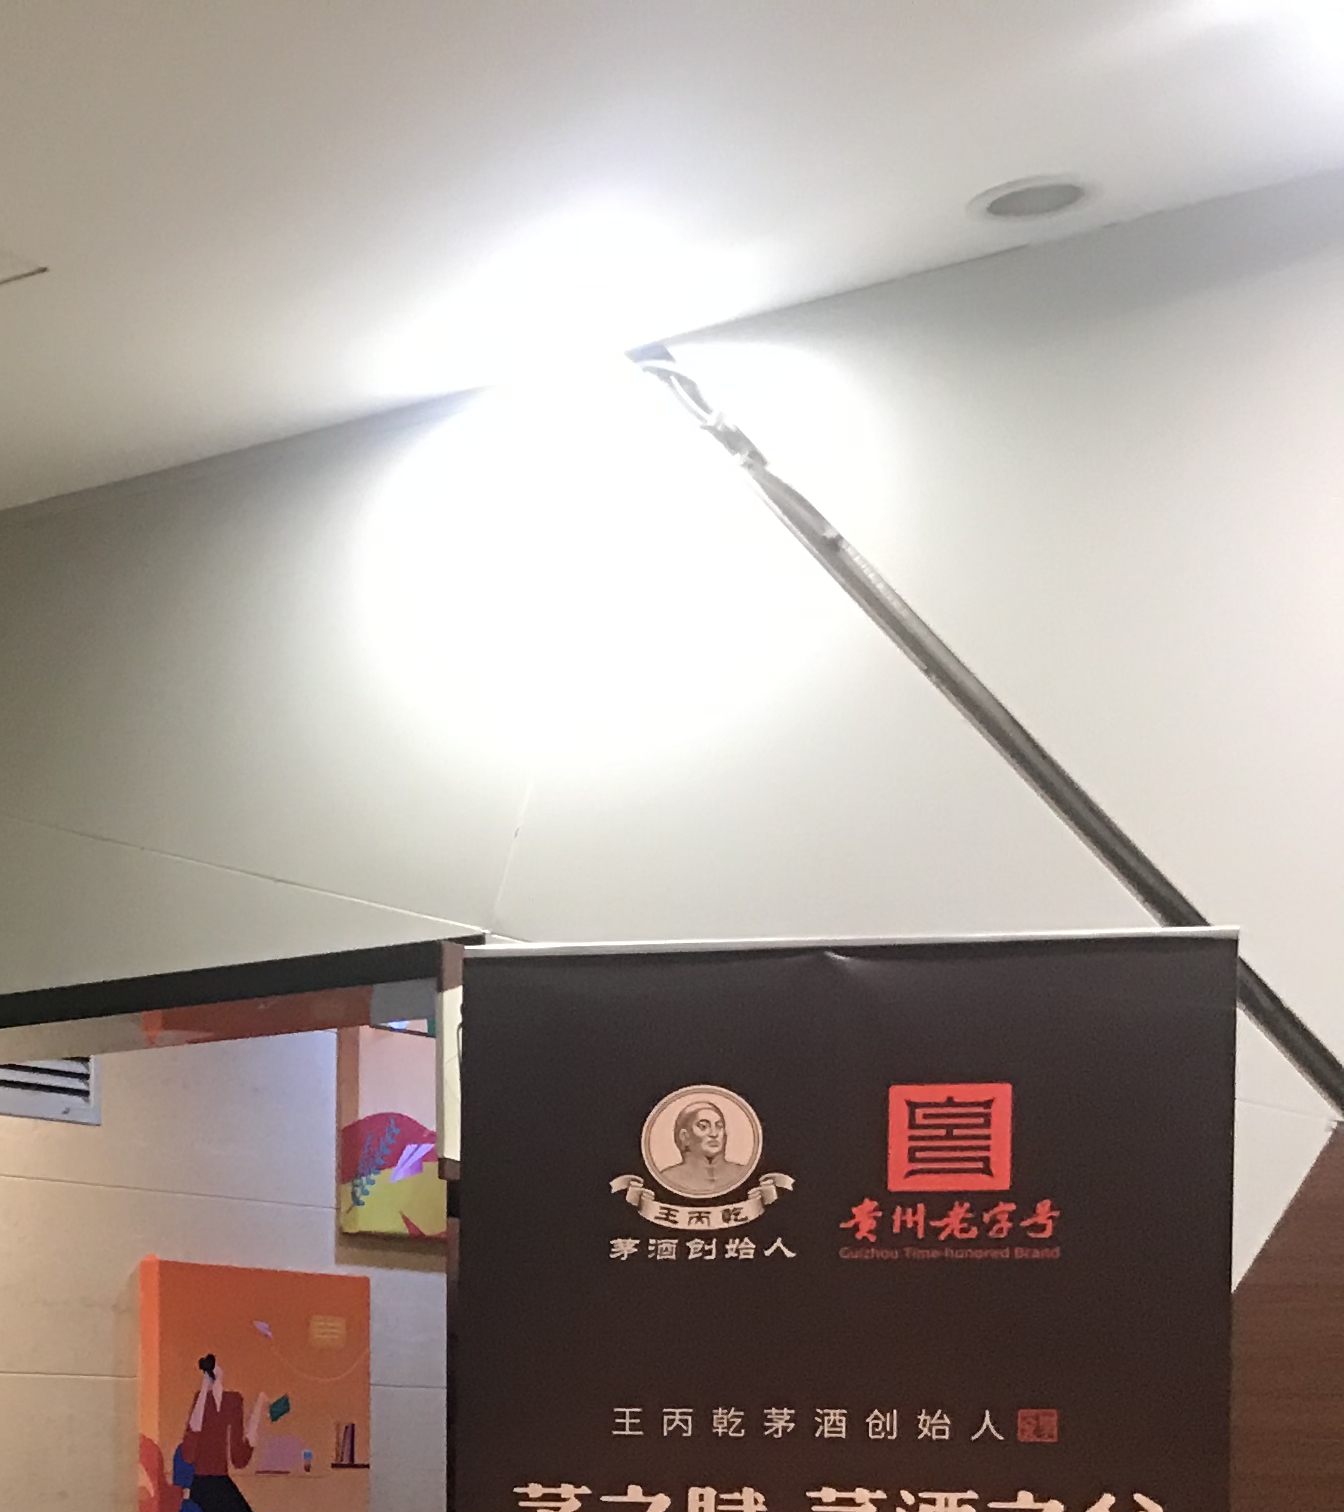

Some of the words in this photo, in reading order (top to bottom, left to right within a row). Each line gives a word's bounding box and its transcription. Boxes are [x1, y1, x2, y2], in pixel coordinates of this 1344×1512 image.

[653, 1204, 749, 1228] 王丙乾
[838, 1246, 899, 1260] Guizhou
[1013, 1246, 1061, 1260] Brand
[612, 1407, 1006, 1442] 王丙乾茅酒创始人
